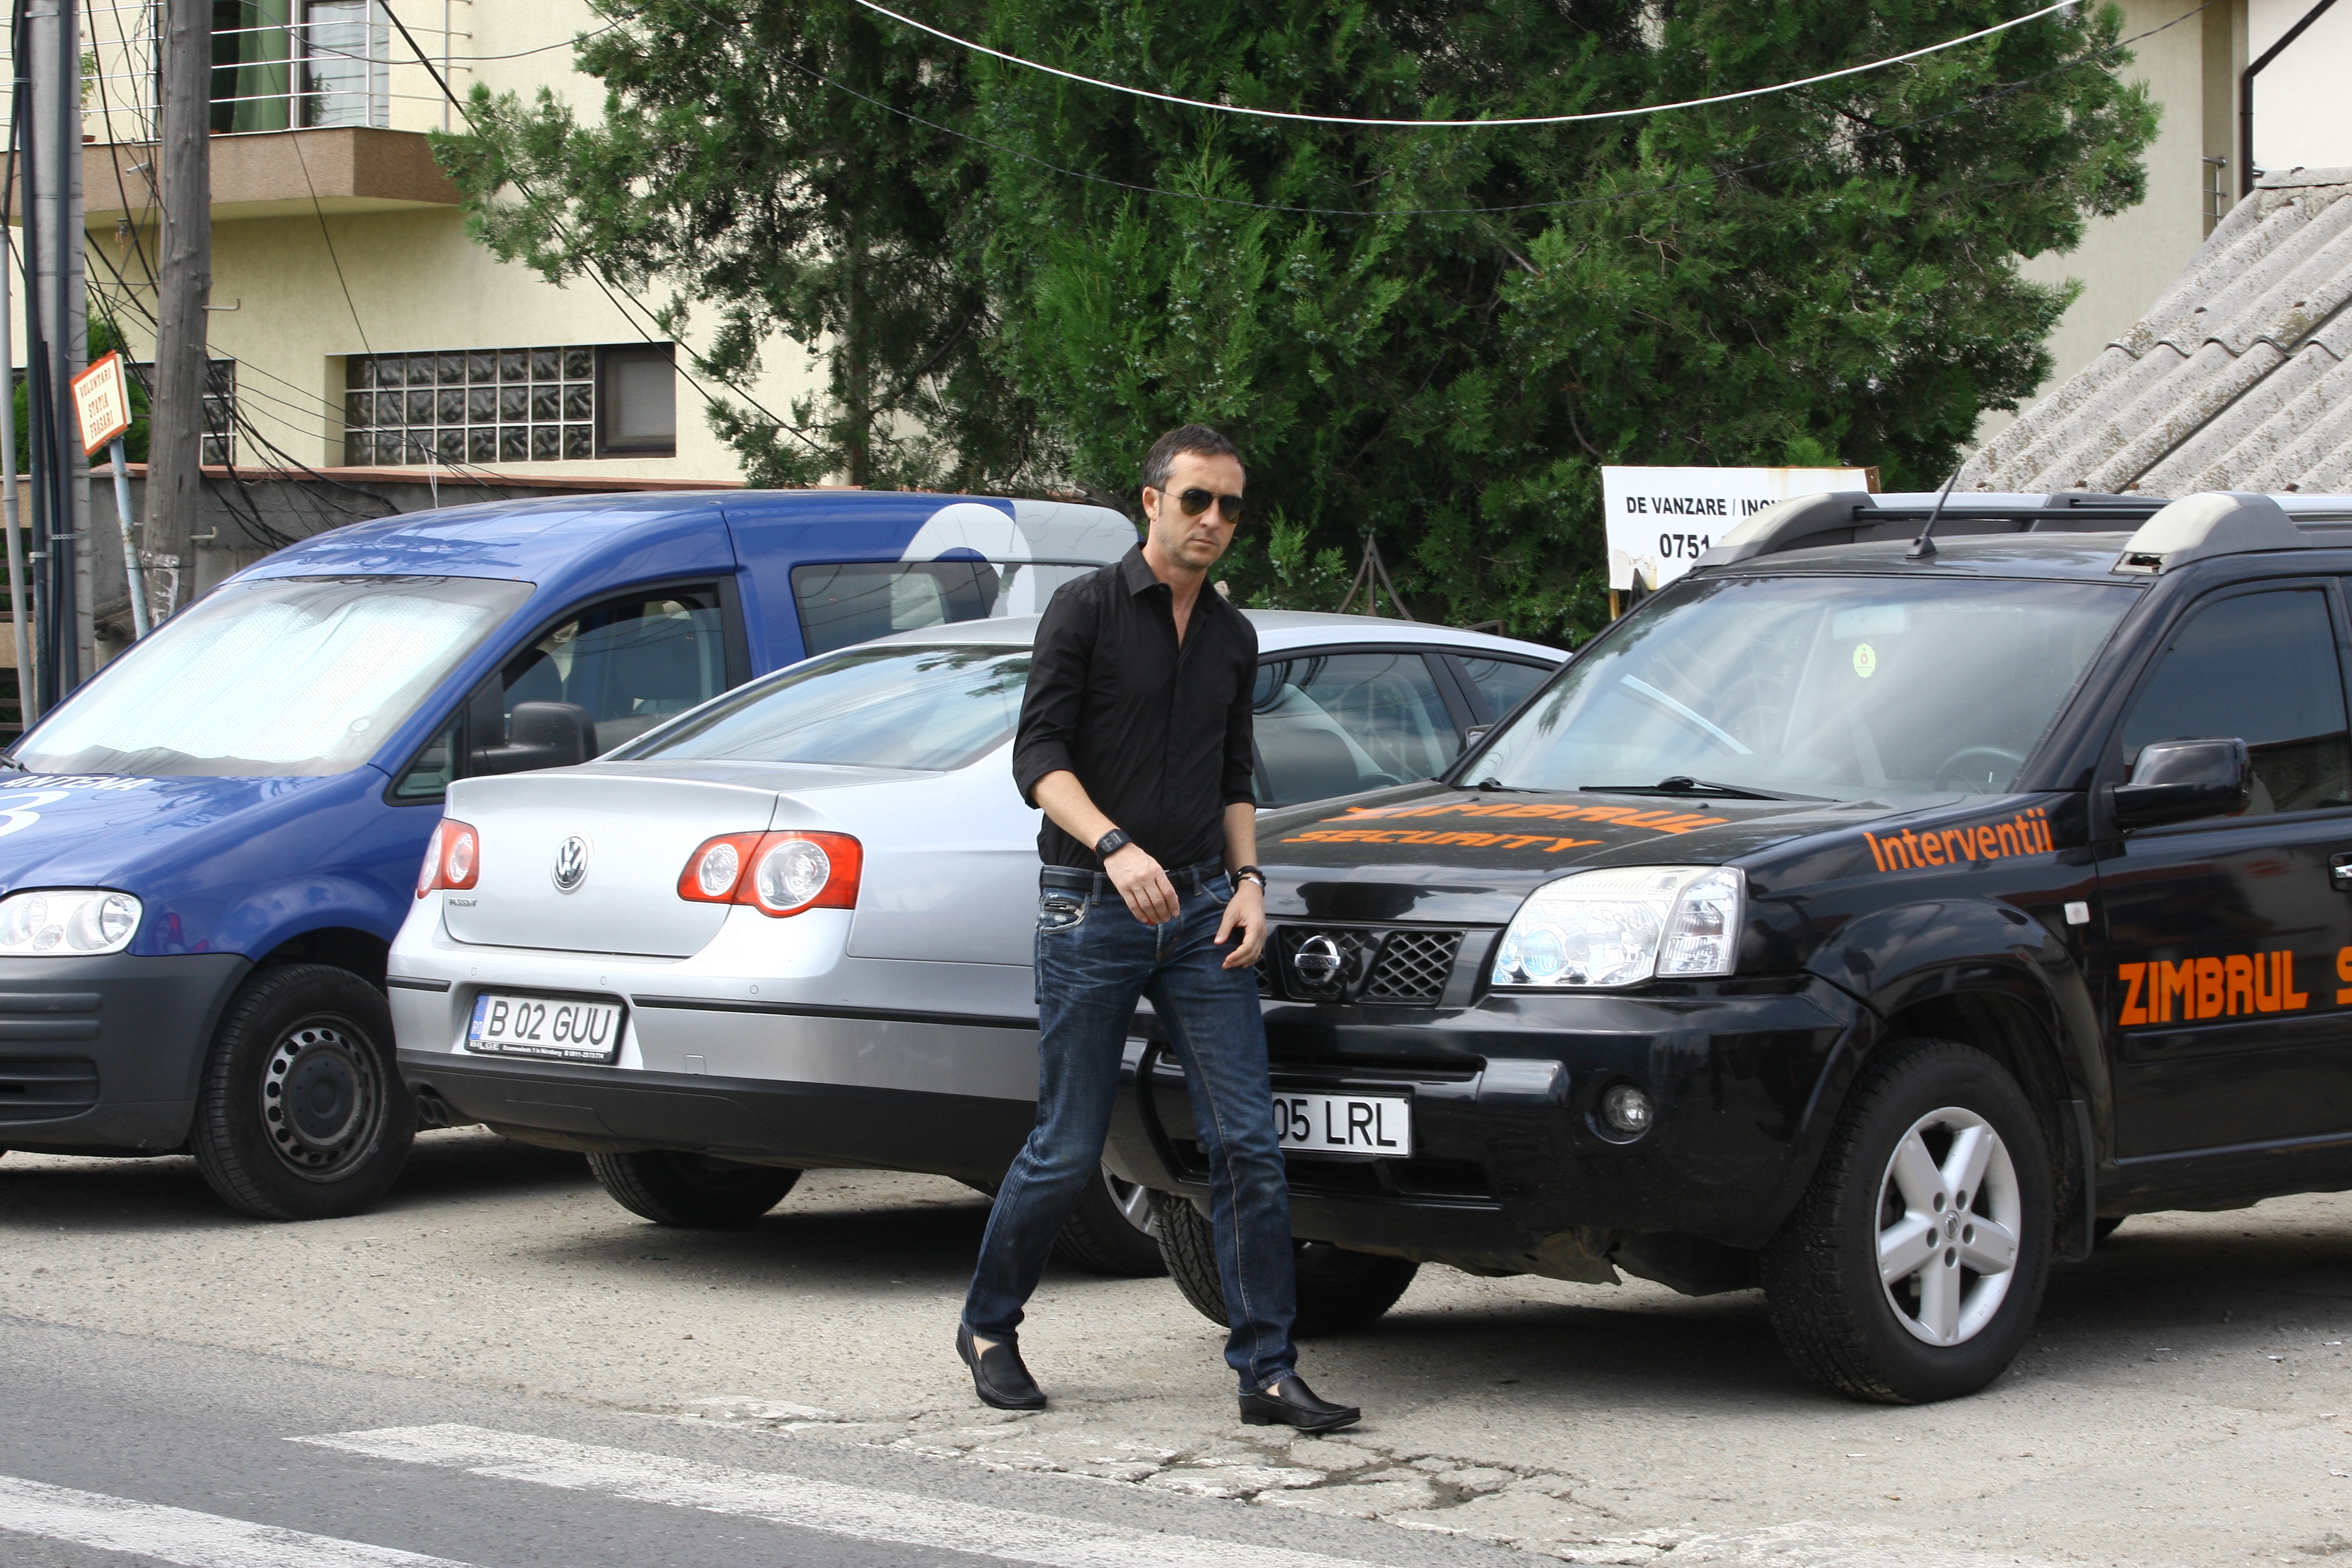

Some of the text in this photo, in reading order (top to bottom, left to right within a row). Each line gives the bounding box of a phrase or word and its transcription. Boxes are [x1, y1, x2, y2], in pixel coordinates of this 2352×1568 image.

[1626, 496, 1647, 514] DE
[1651, 497, 1726, 515] VANZARE
[0, 776, 154, 791] ANTENA
[1319, 804, 1730, 835] ZIMBRUL
[1279, 829, 1605, 852] SECURITY
[1863, 808, 2054, 872] Interventii
[2118, 949, 2309, 1026] ZIMBRUL
[488, 1000, 611, 1046] B 02 GUU
[1272, 1097, 1397, 1148] 05 LRL
